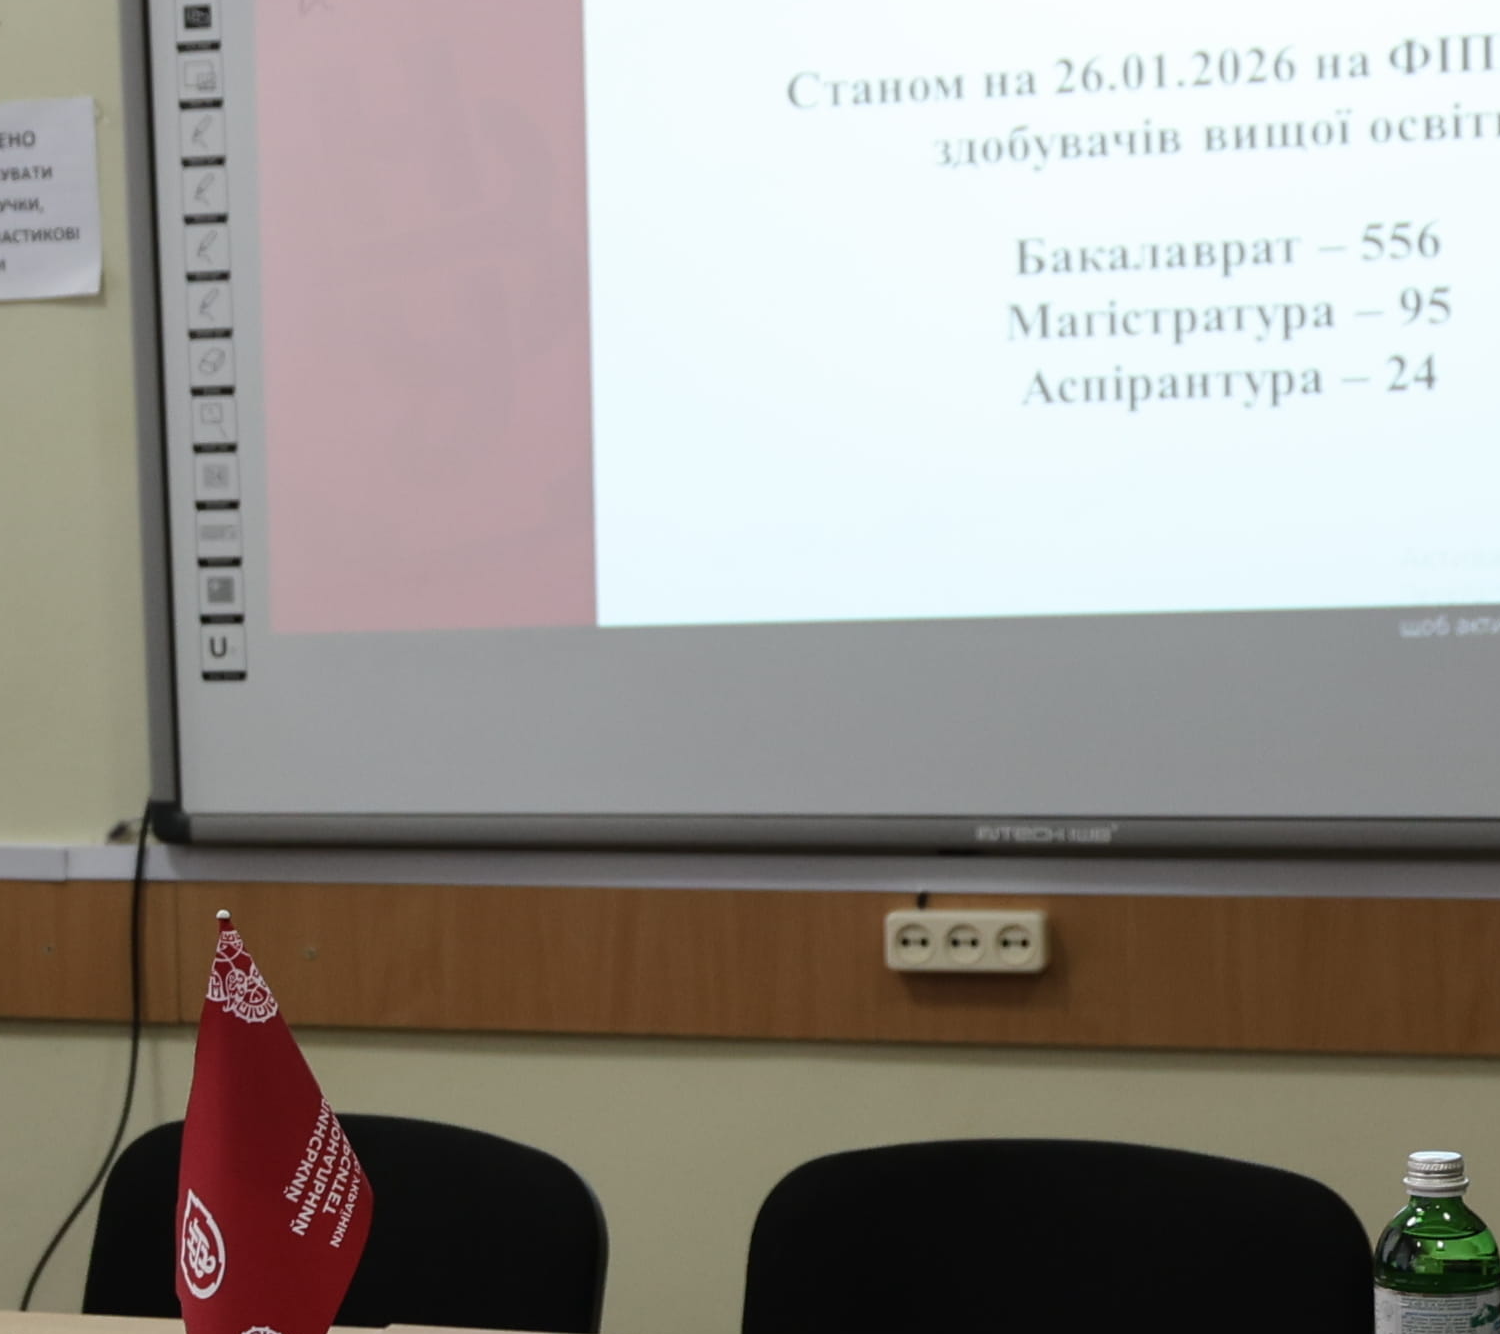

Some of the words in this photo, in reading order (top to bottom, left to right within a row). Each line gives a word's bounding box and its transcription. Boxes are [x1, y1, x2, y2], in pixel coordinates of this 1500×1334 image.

[786, 71, 965, 109] Станом
[984, 69, 1037, 99] на
[1054, 44, 1297, 94] 26.01.2026
[1315, 50, 1371, 80] на
[934, 119, 1182, 170] здобувачів
[1204, 108, 1353, 153] вищої
[1015, 235, 1301, 278] Бакалаврат
[1361, 220, 1441, 262] 556
[1007, 299, 1335, 344] Магістратура
[1400, 285, 1452, 325] 95
[1023, 365, 1323, 411] Аспірантура
[1387, 354, 1437, 392] 24
